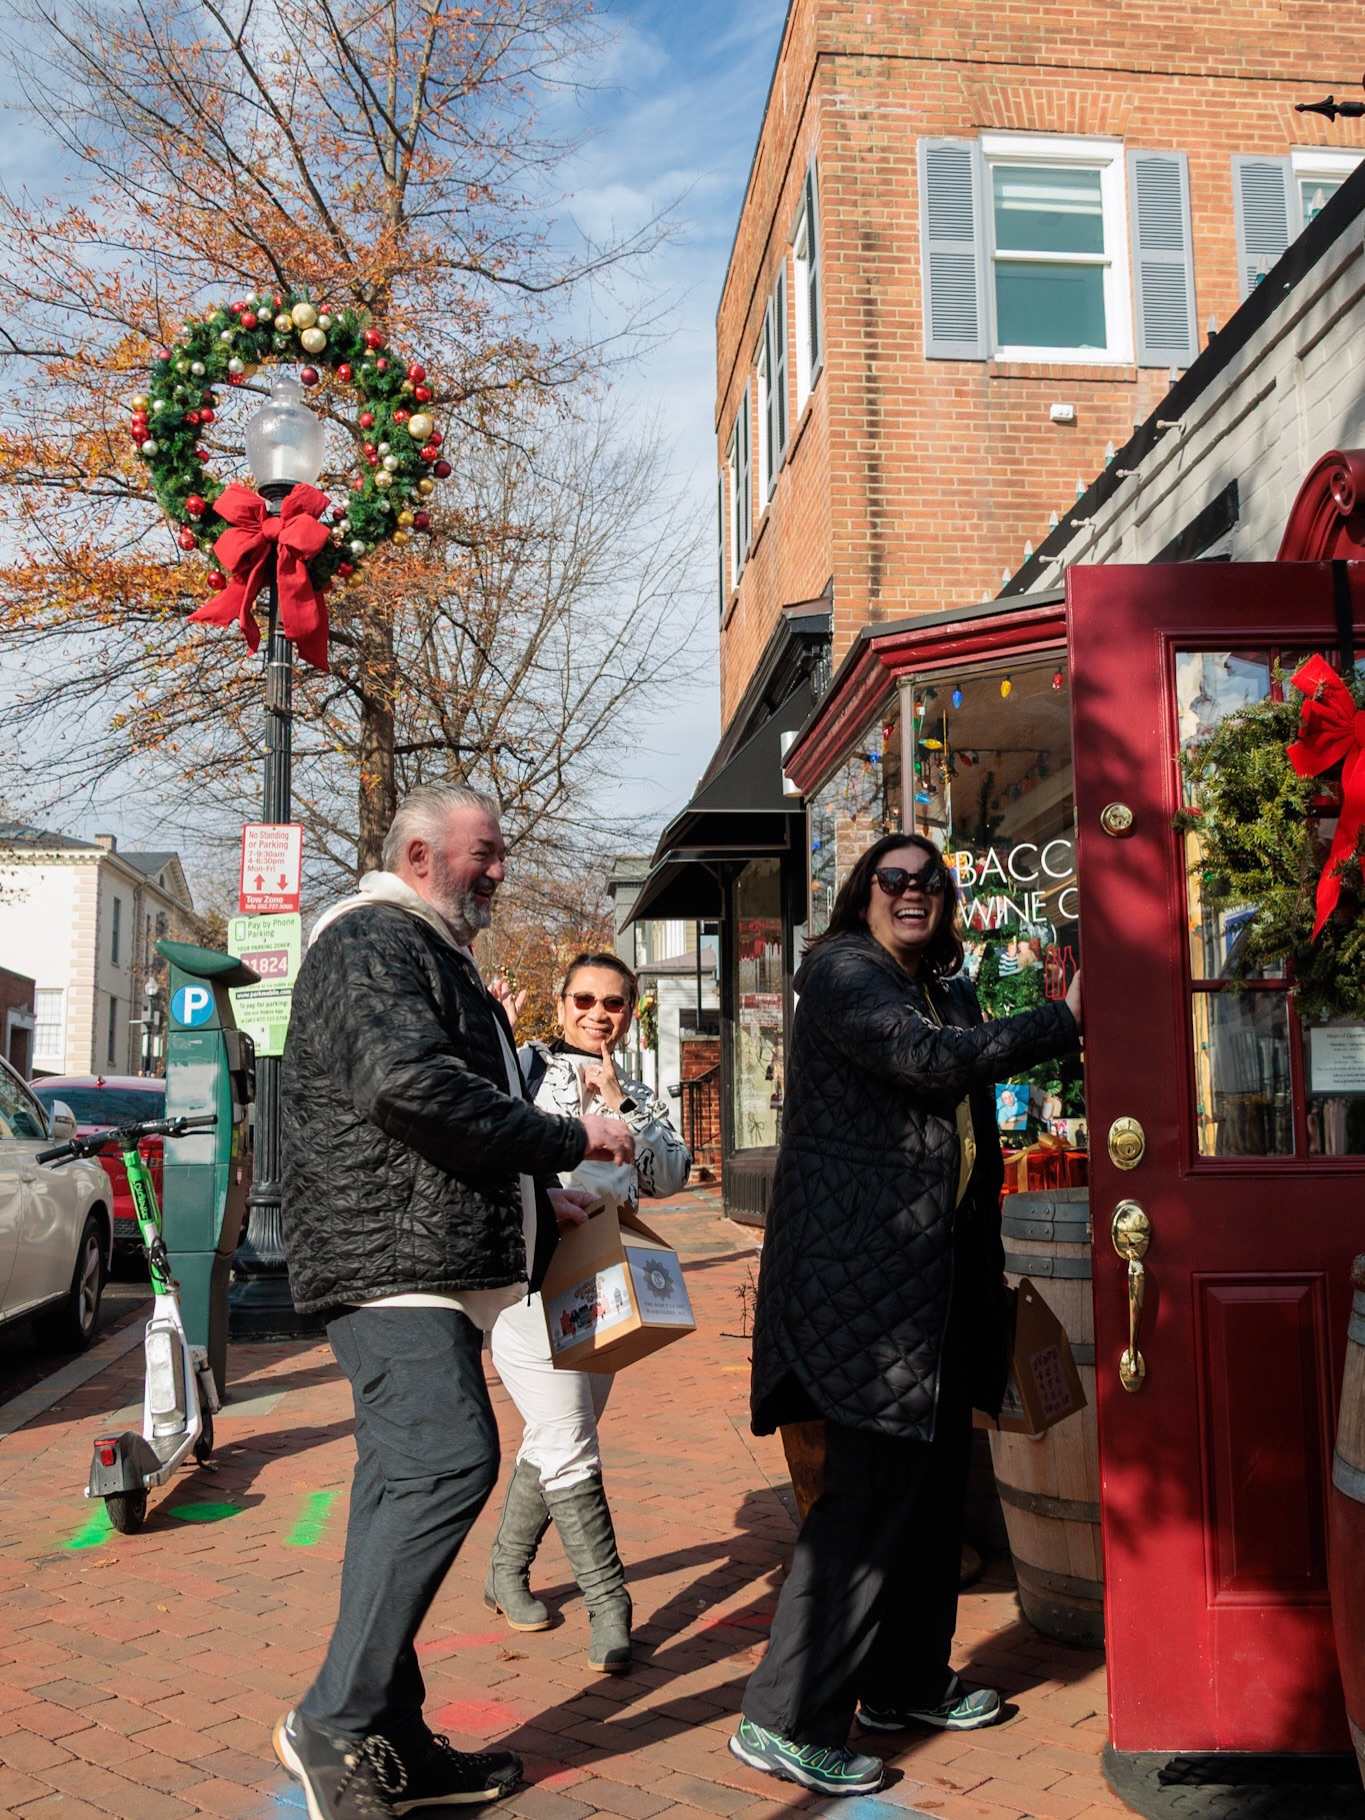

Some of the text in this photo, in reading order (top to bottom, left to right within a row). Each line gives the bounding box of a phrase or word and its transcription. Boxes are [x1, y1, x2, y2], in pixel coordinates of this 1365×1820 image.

[249, 831, 289, 840] No Standing
[258, 841, 288, 850] Parking
[248, 850, 285, 858] 7-9:30am
[247, 865, 276, 873] Mon-Fri
[246, 896, 284, 904] Tow Zone
[959, 890, 1048, 929] WINE
[247, 919, 295, 930] Pay by Phone
[247, 929, 275, 938] Parking
[184, 987, 209, 1024] P
